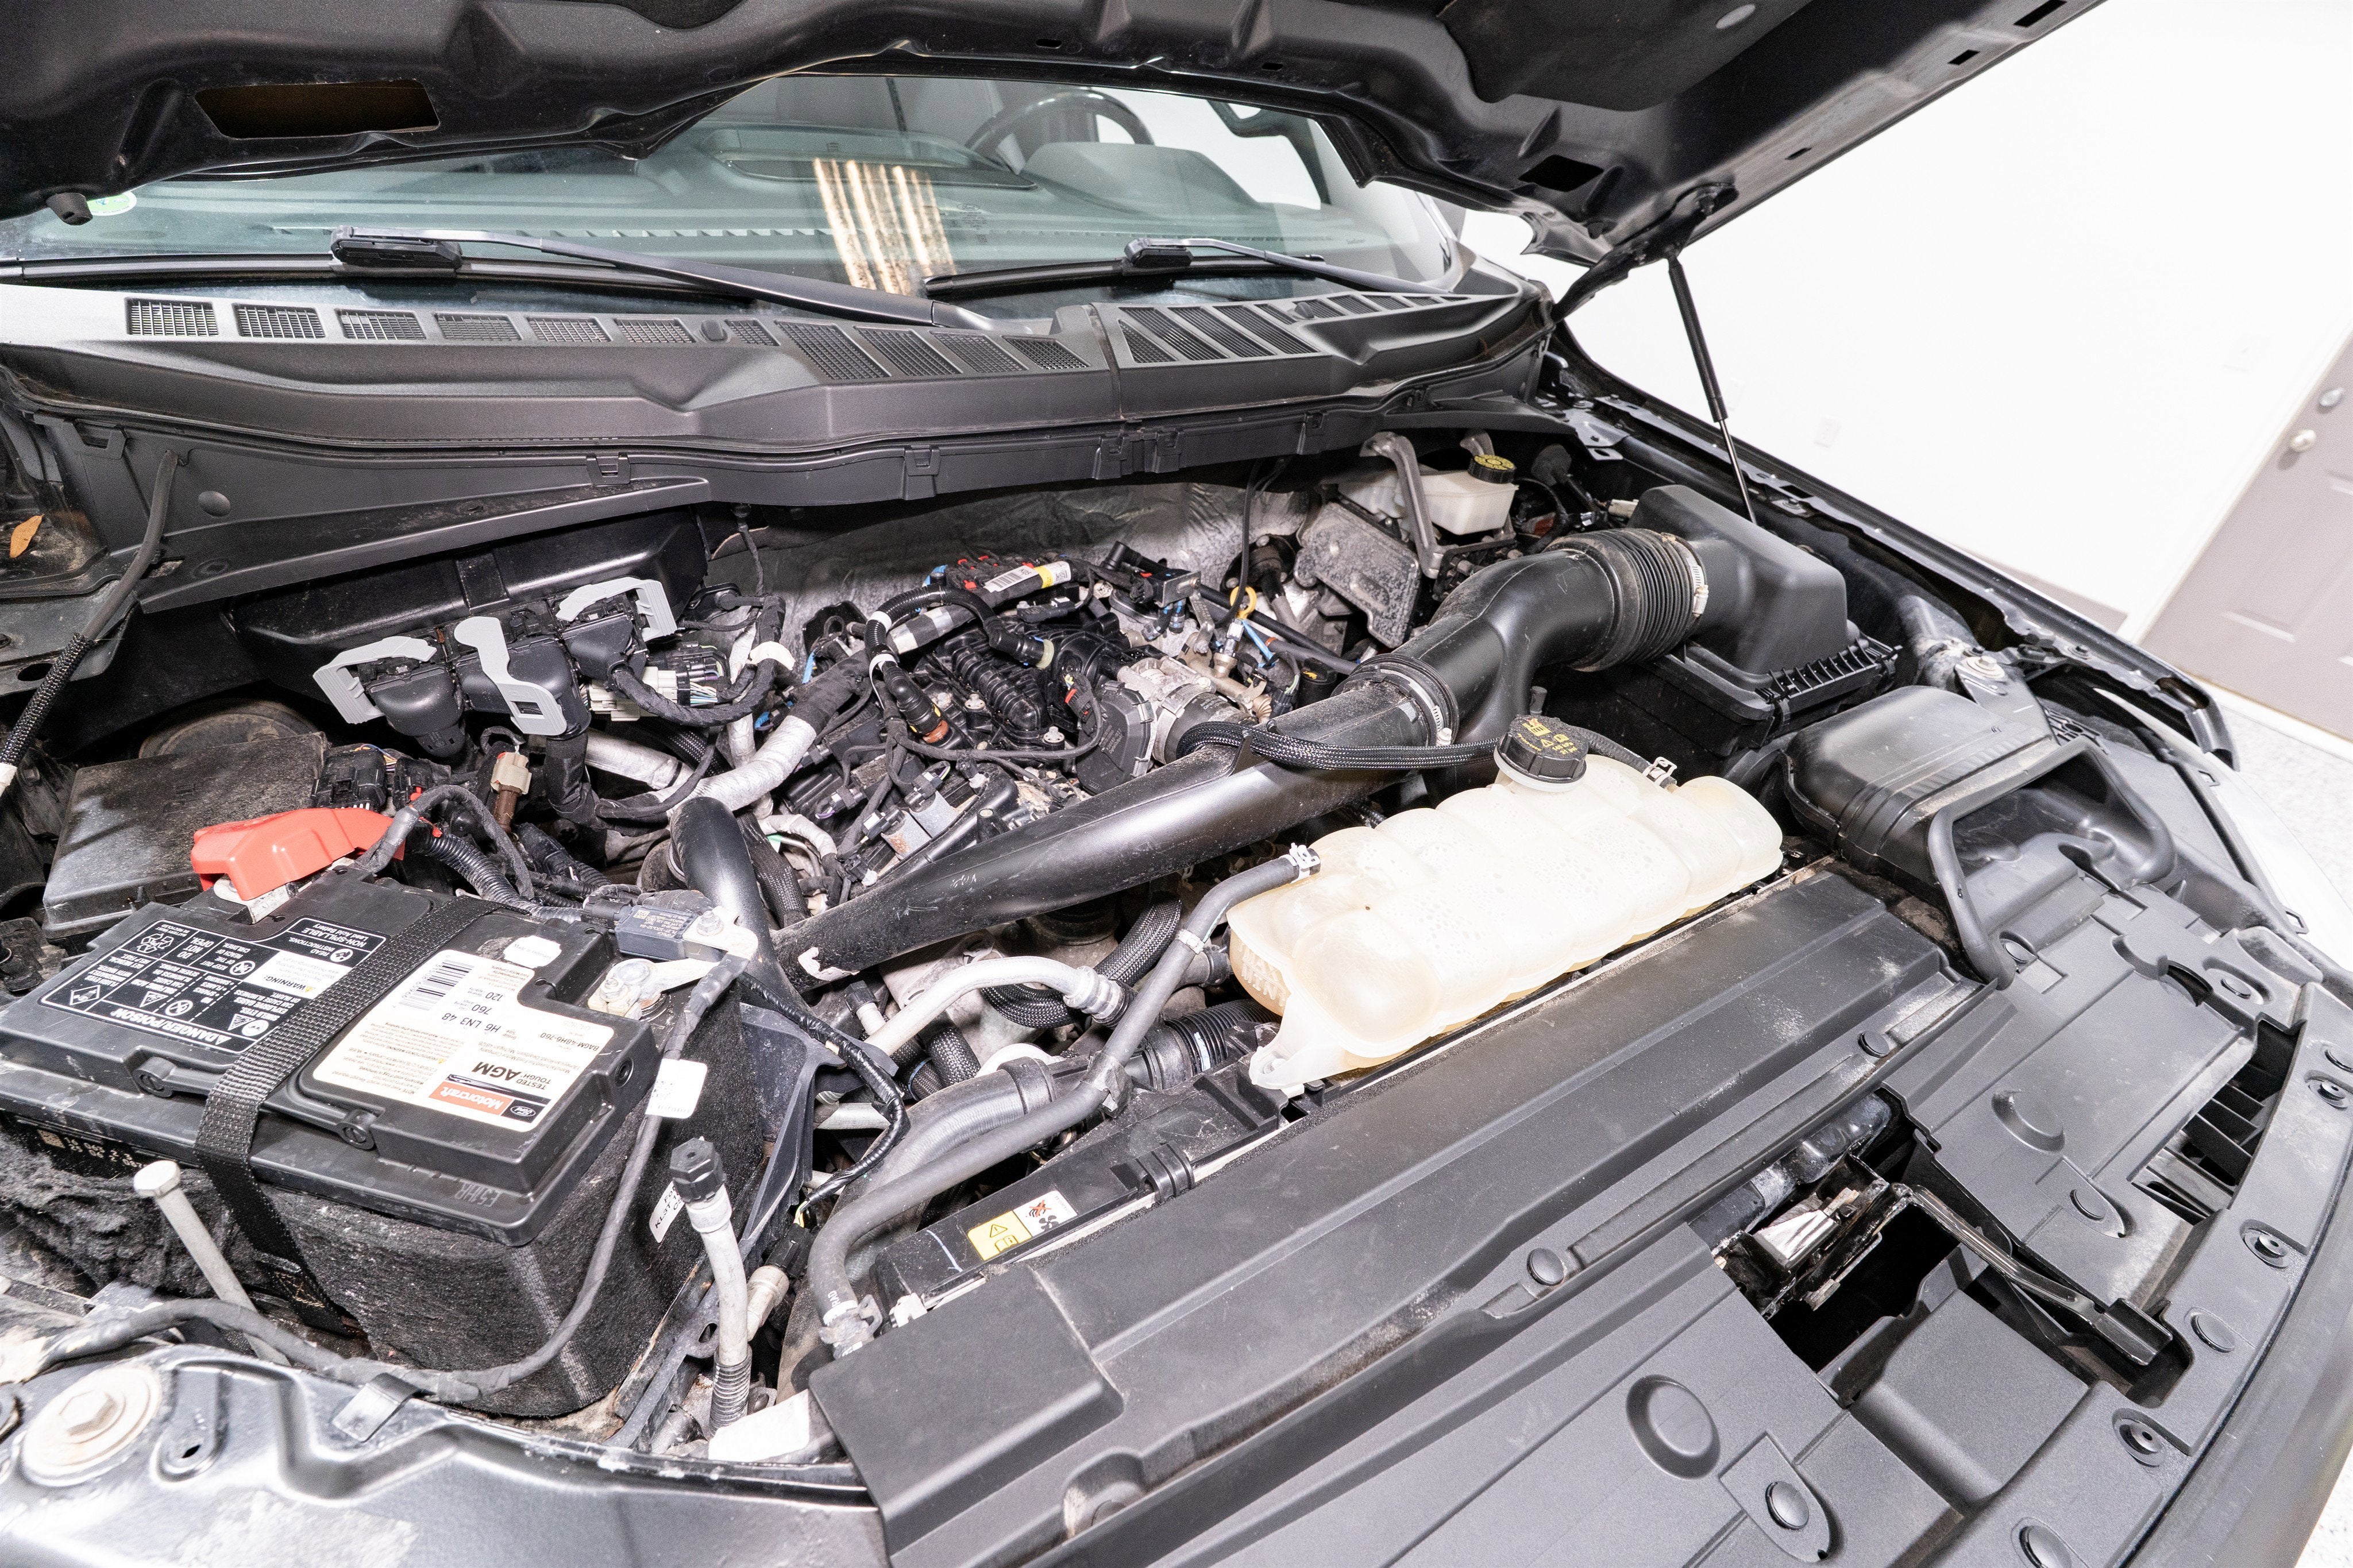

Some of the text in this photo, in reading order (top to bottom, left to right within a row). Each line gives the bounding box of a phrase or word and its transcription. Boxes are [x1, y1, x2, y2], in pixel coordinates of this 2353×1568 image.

[159, 924, 186, 932] RECYCLED
[311, 923, 339, 933] Battery
[186, 937, 216, 947] OPEN.
[299, 927, 368, 947] NON-SPILLABLE
[182, 944, 205, 953] NOT
[219, 942, 253, 952] CHILDREN.
[286, 937, 336, 951] INSTRUCTIONS.
[308, 948, 331, 956] READ
[106, 956, 134, 965] MEDICAL
[160, 971, 194, 982] BLINDNESS
[177, 968, 201, 976] SEVERE
[152, 976, 175, 984] CAUSE
[261, 975, 307, 990] WARNING:
[144, 982, 178, 994] SULFURIC
[232, 989, 267, 1000] BLINDNESS
[484, 991, 504, 1002] 120
[233, 997, 290, 1014] EXPLOSIVE GASES
[261, 996, 286, 1005] CAUSE
[470, 1003, 493, 1015] 760
[252, 1010, 281, 1021] SHIELD
[441, 1012, 458, 1022] 48
[111, 1007, 221, 1041] DANGER/POISON
[459, 1017, 482, 1028] LN3
[483, 1023, 501, 1033] H6
[539, 1032, 600, 1051] BAGM-48H6-760
[470, 1061, 522, 1082] AGM
[515, 1077, 547, 1090] TESTED
[437, 1086, 505, 1109] Motorcraft
